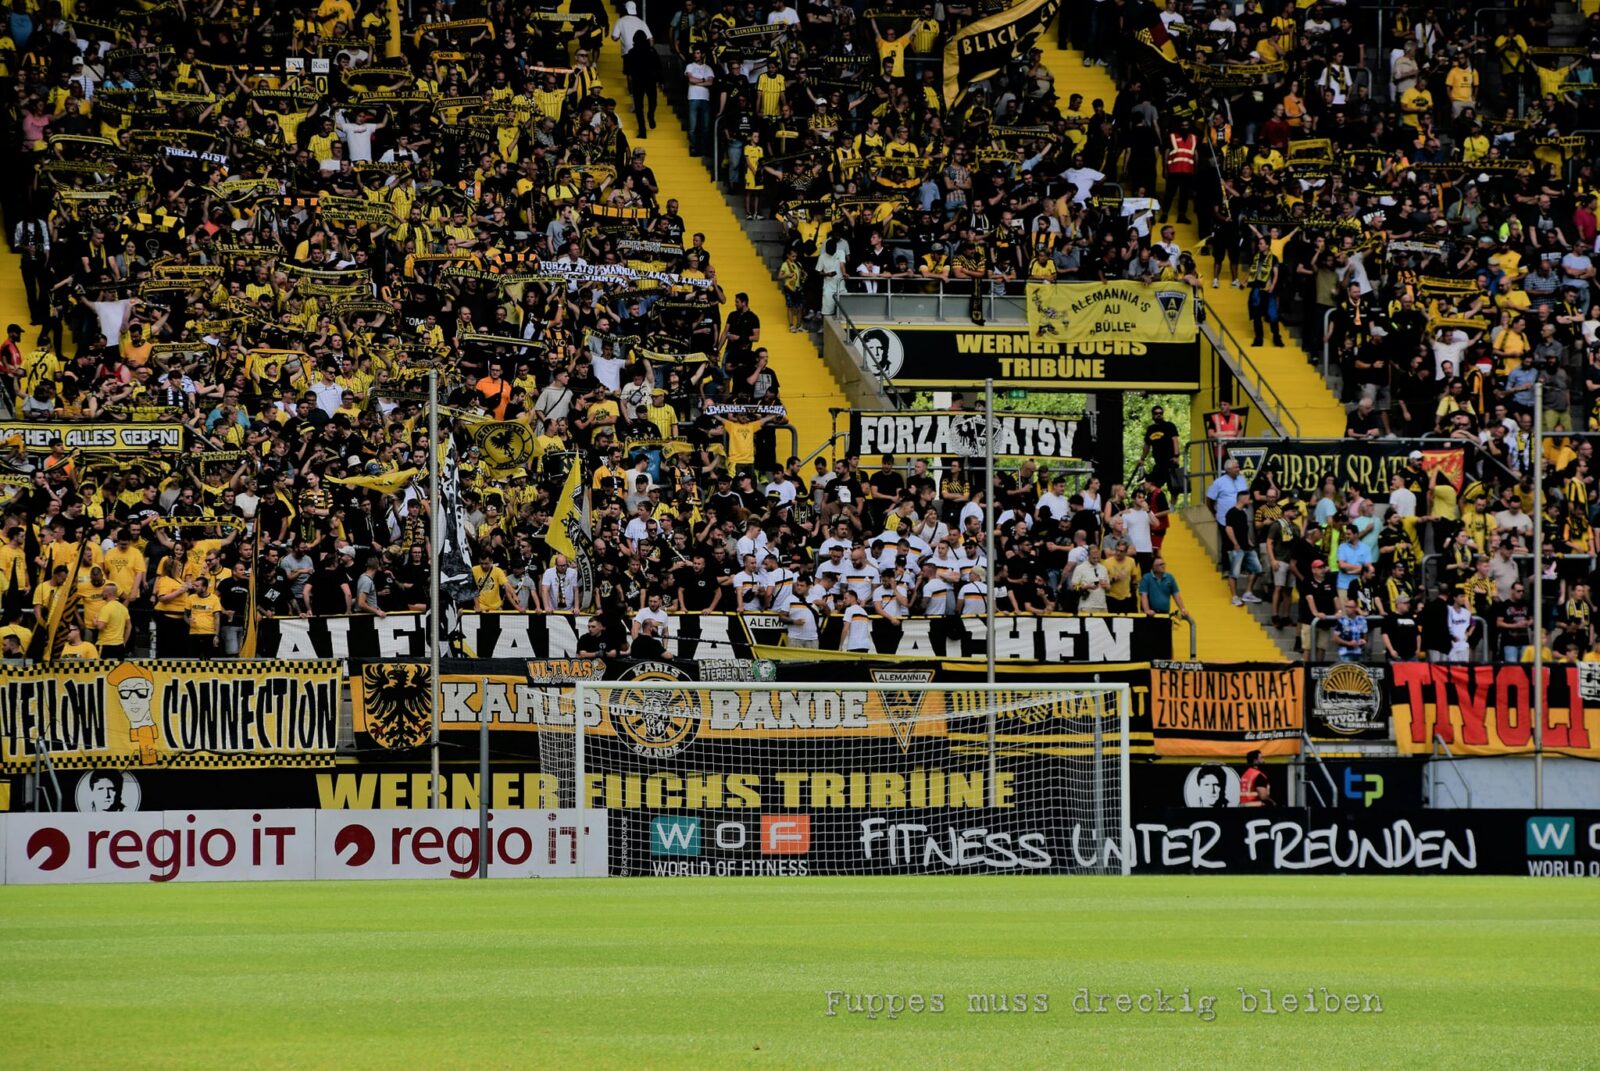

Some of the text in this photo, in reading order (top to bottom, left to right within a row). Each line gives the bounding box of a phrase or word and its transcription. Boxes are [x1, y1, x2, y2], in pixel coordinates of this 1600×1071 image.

[961, 24, 1018, 55] BLACK
[313, 58, 329, 69] Rest
[293, 91, 320, 100] AACHEN
[317, 77, 327, 93] 0
[1535, 136, 1586, 145] LEMANNI
[165, 147, 228, 164] FORZA ATSV
[540, 261, 572, 272] FORZA
[1071, 288, 1151, 314] ALEMANNIA'S
[1104, 304, 1121, 314] AU
[956, 334, 1063, 355] WERNER
[999, 354, 1106, 379] TRIBÜNE
[0, 429, 178, 446] ACHEN ALLES GEBEN!
[861, 416, 1078, 457] FORZA ATSV
[1267, 453, 1410, 494] GIRBELSRAT
[577, 553, 592, 592] AACHEN
[838, 616, 1134, 662] ACHEN
[528, 660, 593, 678] ULTRAS
[632, 663, 680, 678] KARLS
[878, 673, 927, 682] ALEMANNIA
[1159, 669, 1297, 701] FREUNDSCHAFT
[0, 677, 107, 756] YELLOW
[162, 677, 339, 750] CONNECTION
[441, 682, 868, 729] KARLS BANDE
[1158, 698, 1297, 731] ZUSAMMENHALT
[1392, 661, 1592, 749] TIVOLI
[1326, 711, 1368, 725] TIVOLI
[633, 744, 680, 758] BANDE
[316, 767, 1015, 809] WERNER FUCHS TRIBÜNE
[88, 813, 296, 882] regio iT
[392, 813, 533, 879] regio
[860, 817, 1477, 869] FITNESS UNTER FREUNDEN
[653, 860, 808, 877] WORLD OF FITNESS
[1528, 860, 1585, 877] WORLD
